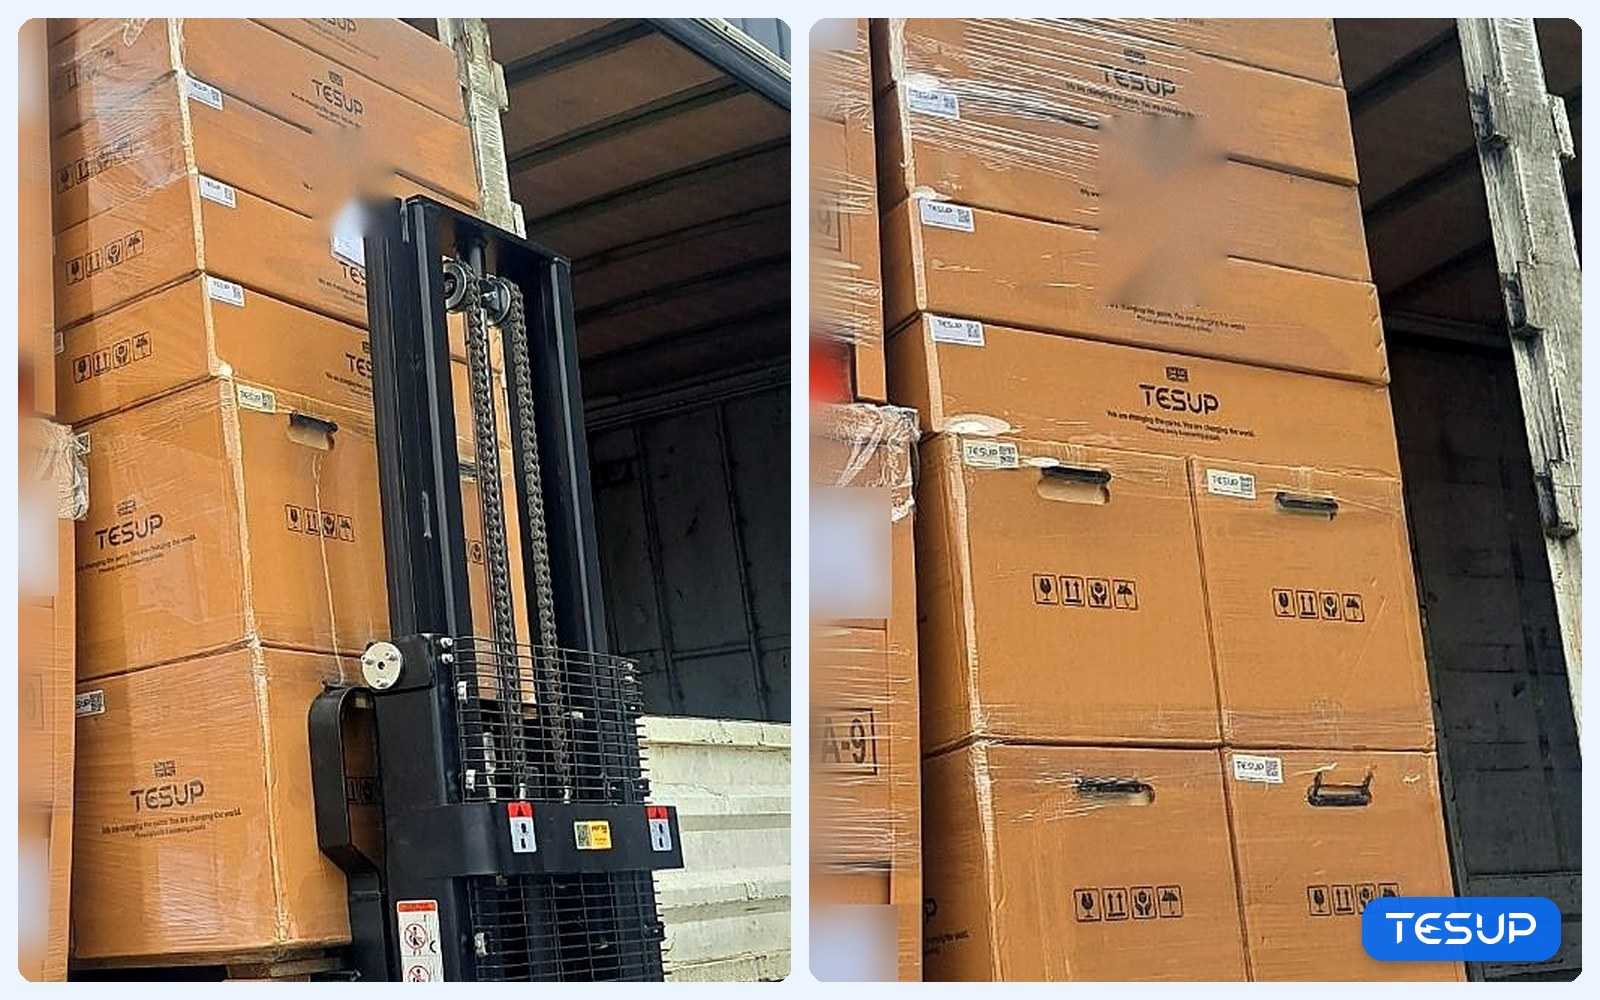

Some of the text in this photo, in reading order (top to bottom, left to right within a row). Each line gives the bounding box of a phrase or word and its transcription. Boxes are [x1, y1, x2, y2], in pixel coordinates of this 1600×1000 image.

[1098, 63, 1176, 97] TESUP
[311, 79, 363, 115] TESUP
[1139, 383, 1220, 415] TESUP
[967, 446, 998, 457] TESUP
[1211, 475, 1239, 486] TESUP
[96, 513, 163, 550] TESUP
[1236, 760, 1265, 771] TESUP
[130, 778, 205, 813] TESUP
